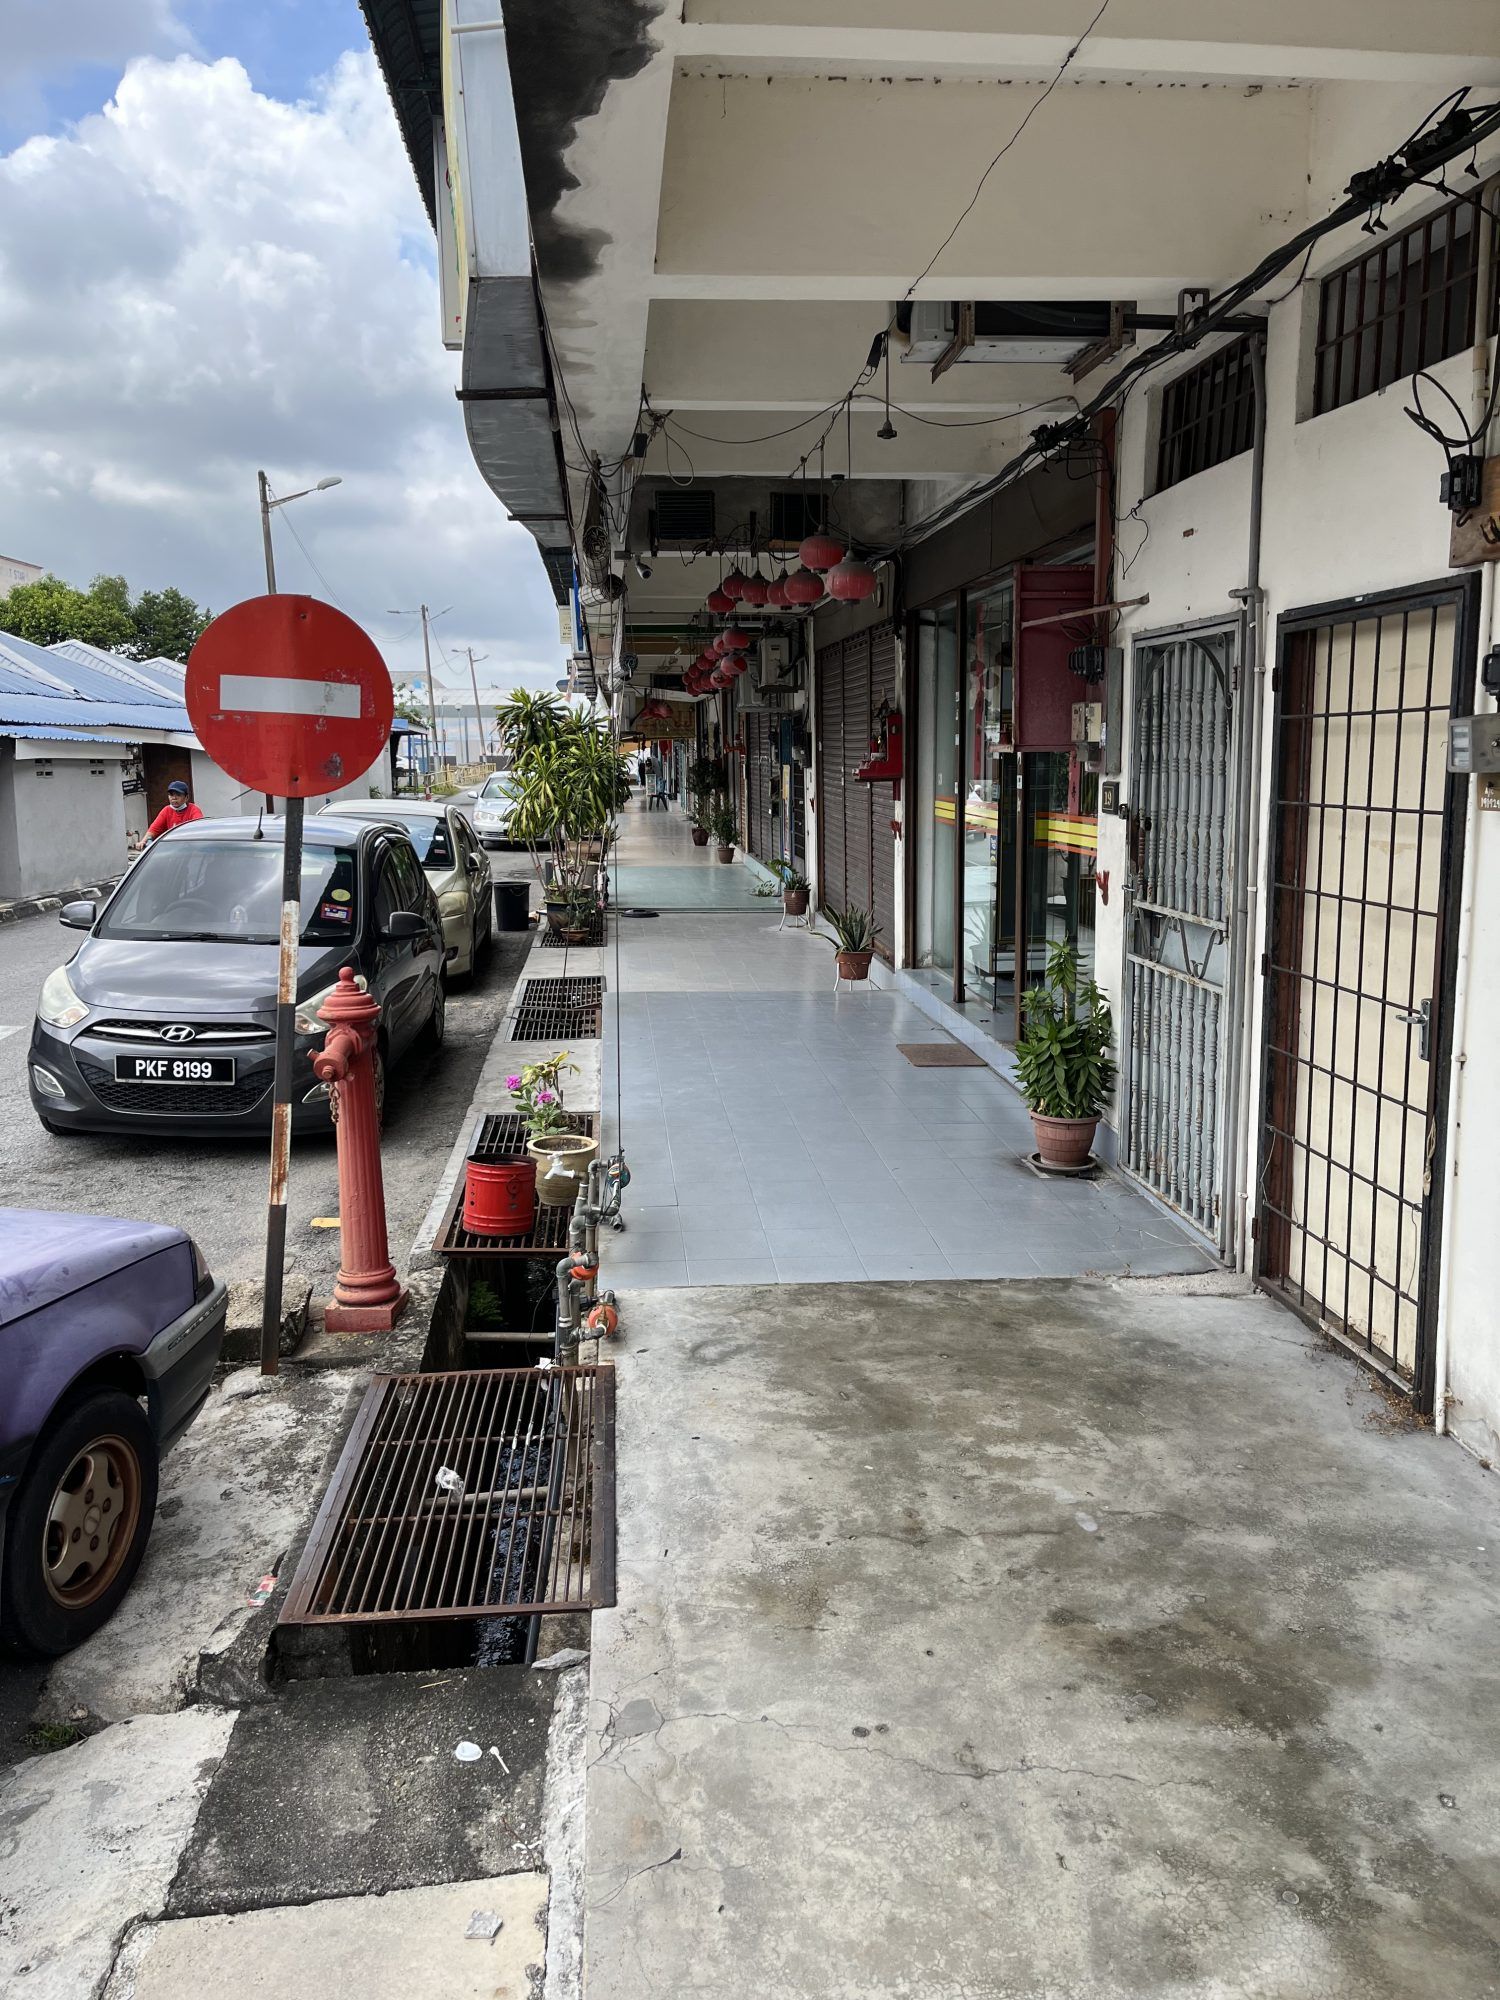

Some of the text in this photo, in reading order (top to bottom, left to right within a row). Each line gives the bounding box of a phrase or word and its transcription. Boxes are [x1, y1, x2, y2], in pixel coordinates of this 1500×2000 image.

[1104, 791, 1112, 806] 19
[135, 1060, 212, 1078] PKF 8199
